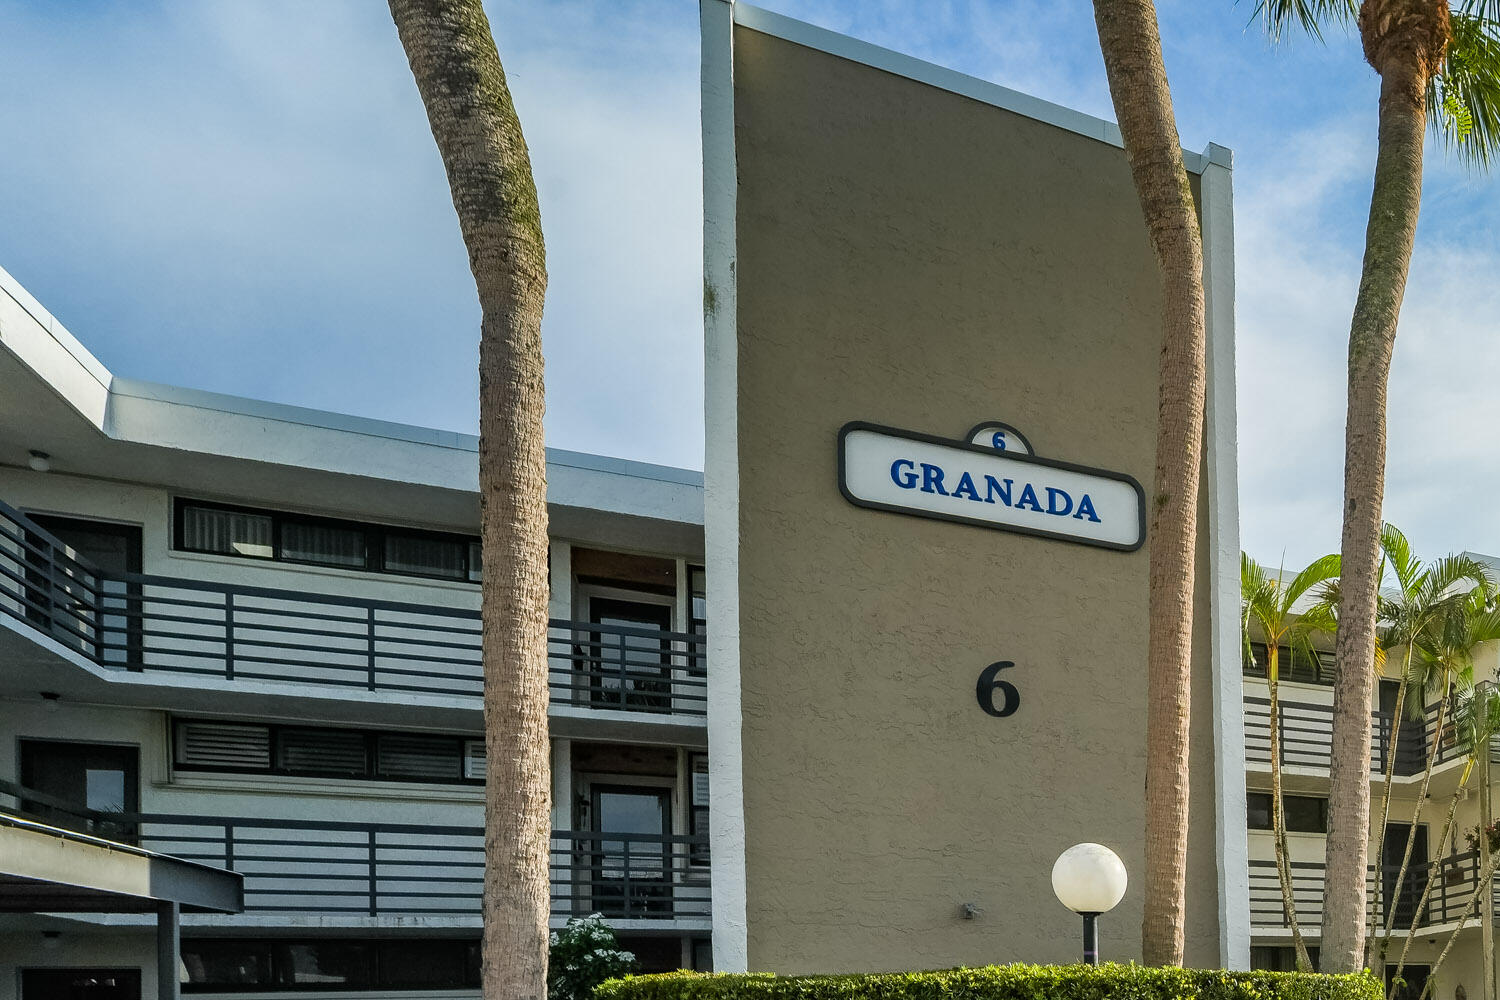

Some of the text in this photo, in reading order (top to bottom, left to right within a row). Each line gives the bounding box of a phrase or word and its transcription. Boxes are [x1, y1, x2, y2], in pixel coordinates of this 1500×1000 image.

[992, 431, 1006, 450] 6
[890, 458, 1101, 522] GRANADA
[976, 660, 1020, 718] 6
